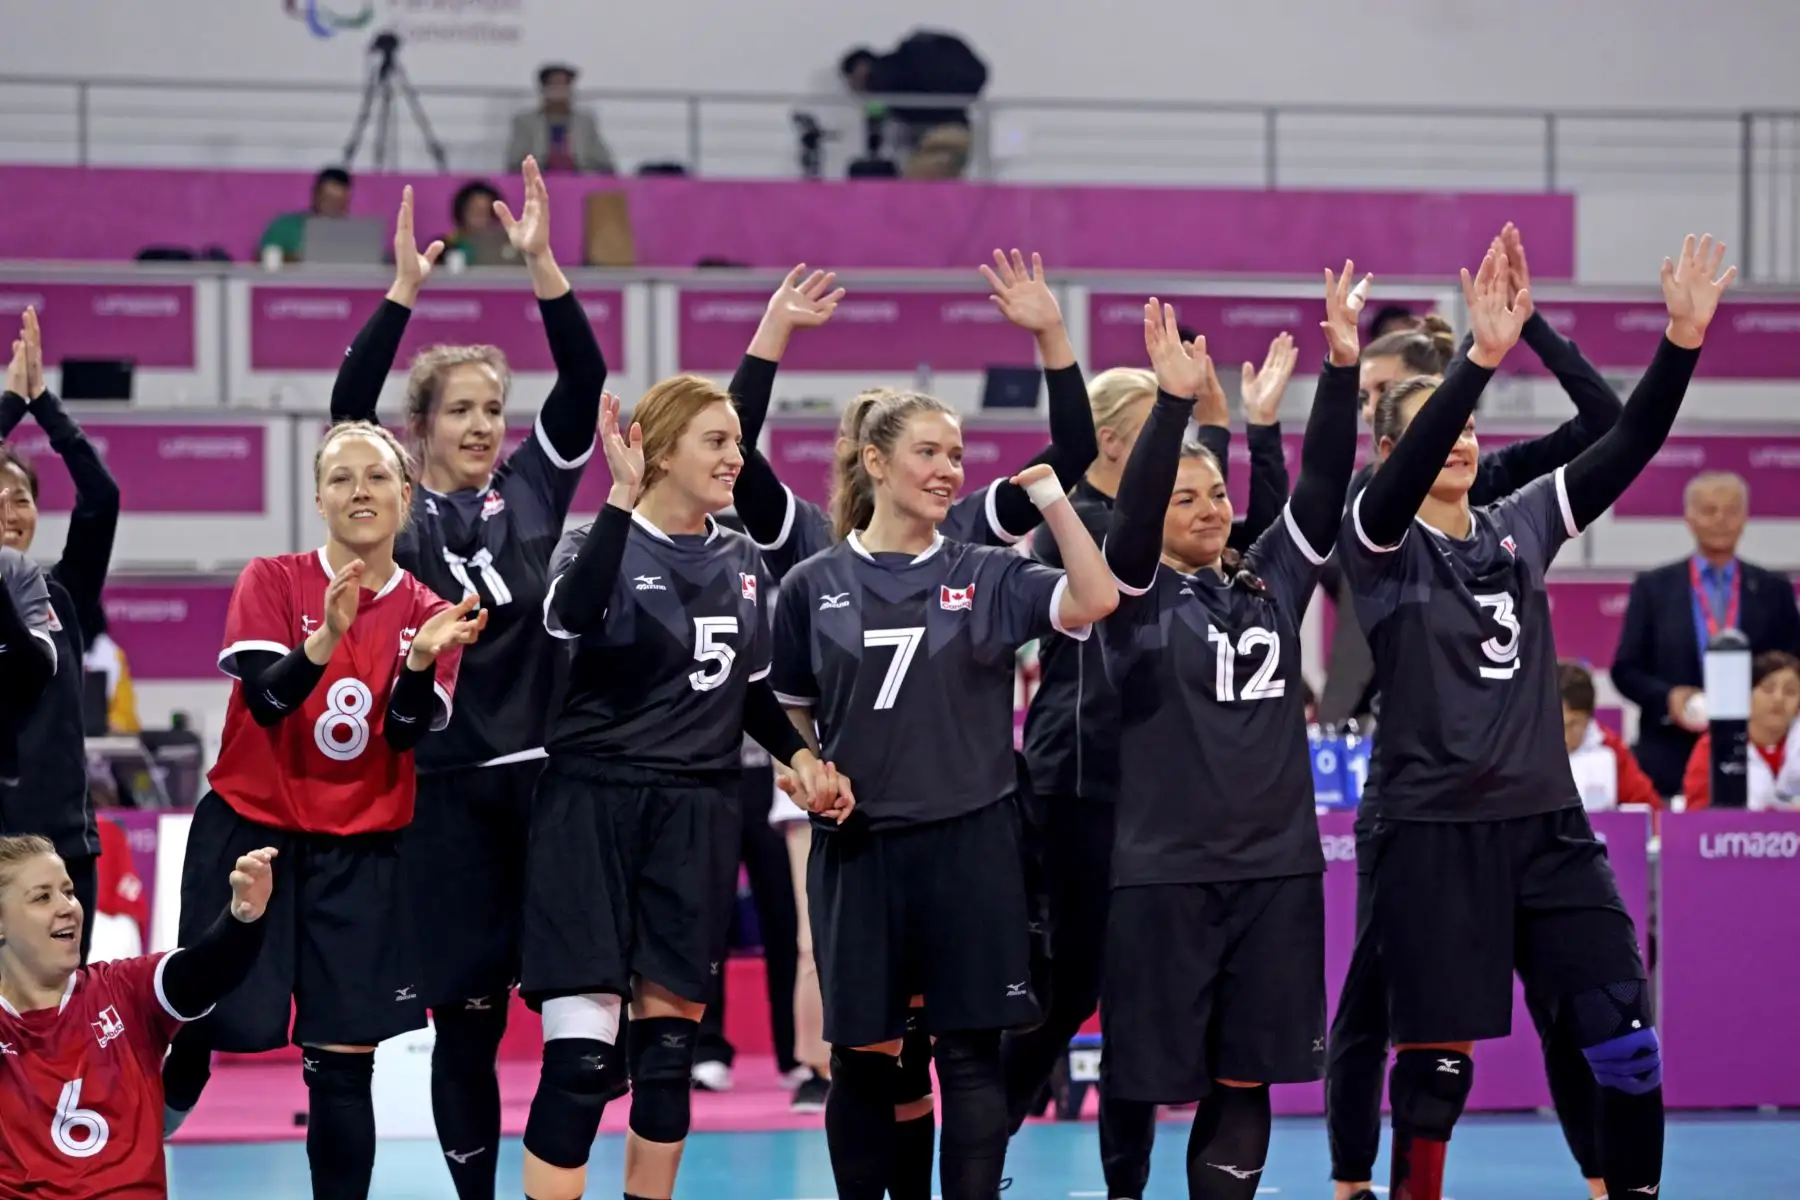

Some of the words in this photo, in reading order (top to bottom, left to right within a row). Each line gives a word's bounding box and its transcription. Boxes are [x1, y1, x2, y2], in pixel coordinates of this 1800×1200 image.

[688, 616, 739, 691] 5
[1207, 623, 1286, 701] 12
[1474, 591, 1521, 663] 3
[864, 627, 926, 710] 7
[314, 677, 373, 761] 8
[51, 1078, 109, 1158] 6
